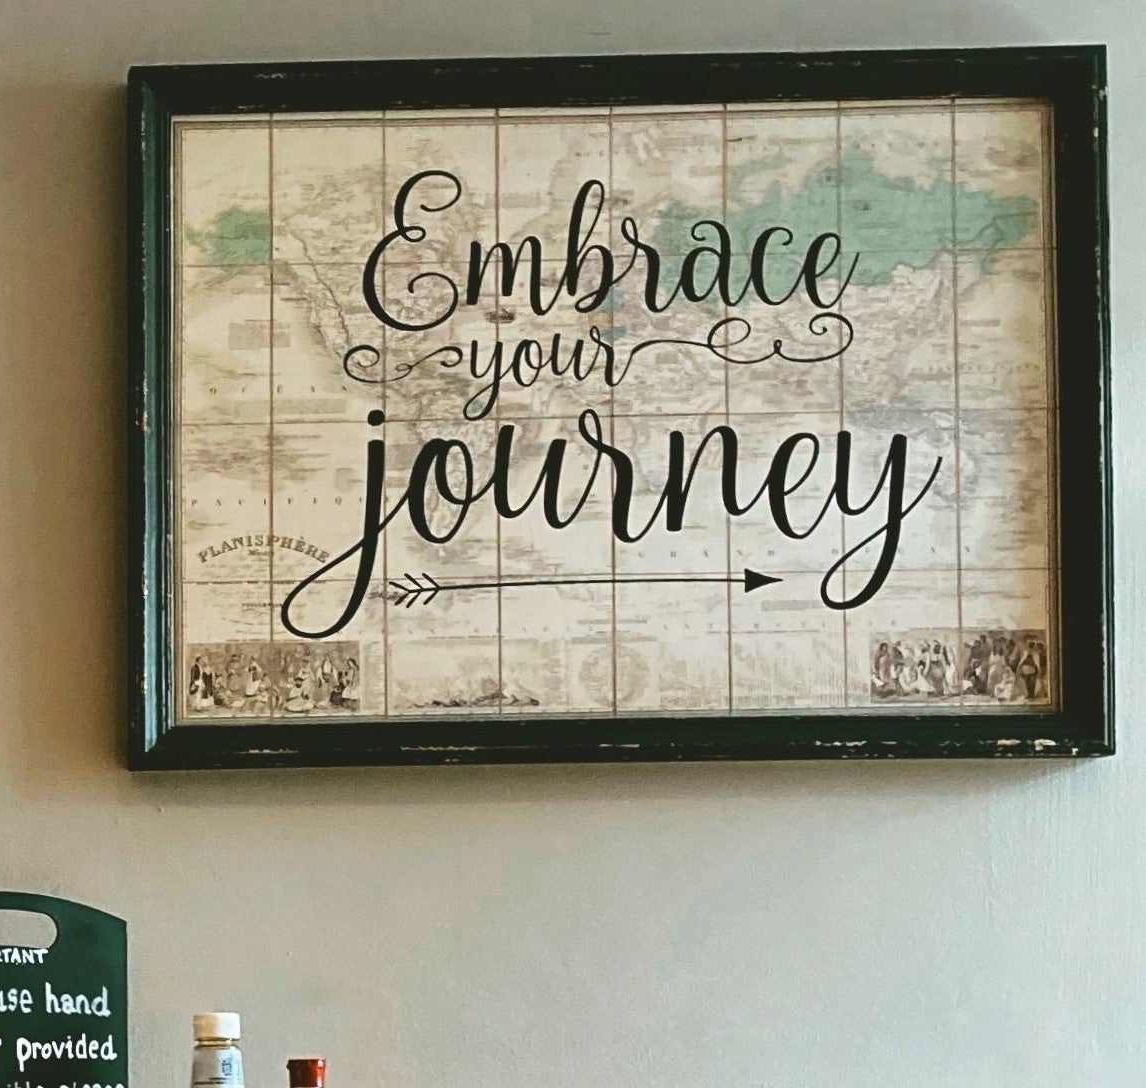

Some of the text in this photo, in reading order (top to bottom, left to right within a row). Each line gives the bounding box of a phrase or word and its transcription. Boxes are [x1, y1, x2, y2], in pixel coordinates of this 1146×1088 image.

[362, 170, 860, 332] Embrace
[462, 325, 635, 421] your
[280, 408, 943, 640] journey
[45, 981, 112, 1018] hand
[16, 1032, 119, 1073] provided
